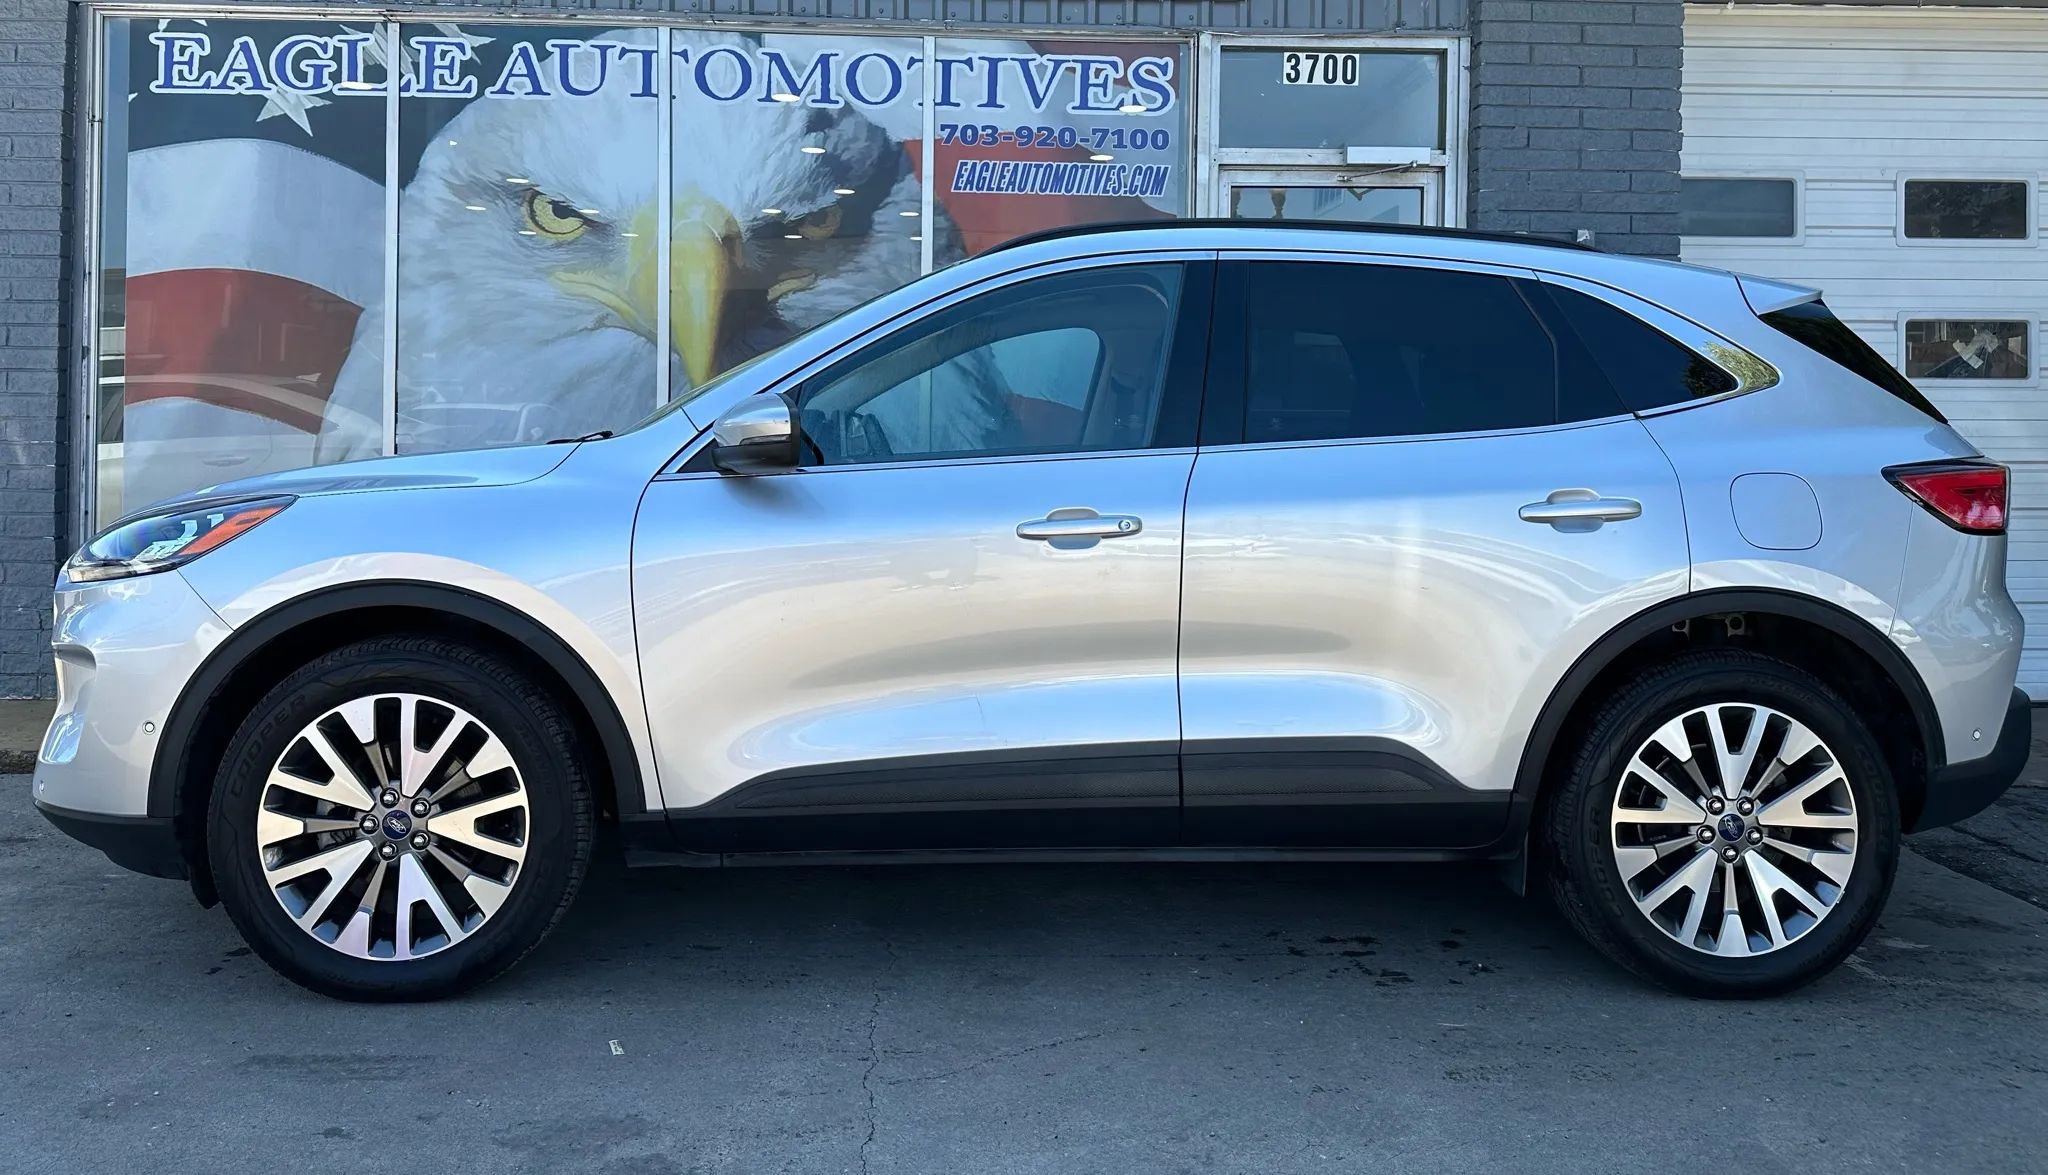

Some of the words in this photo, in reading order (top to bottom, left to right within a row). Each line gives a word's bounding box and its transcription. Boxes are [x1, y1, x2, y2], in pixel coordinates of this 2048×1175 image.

[150, 33, 477, 97] EAGLE
[486, 40, 1173, 115] AUTOMOTIVES
[1285, 53, 1357, 84] 3700
[940, 124, 1170, 150] 703-920-7100
[951, 160, 1170, 197] EAGLEAUTOMOTIVES.COM
